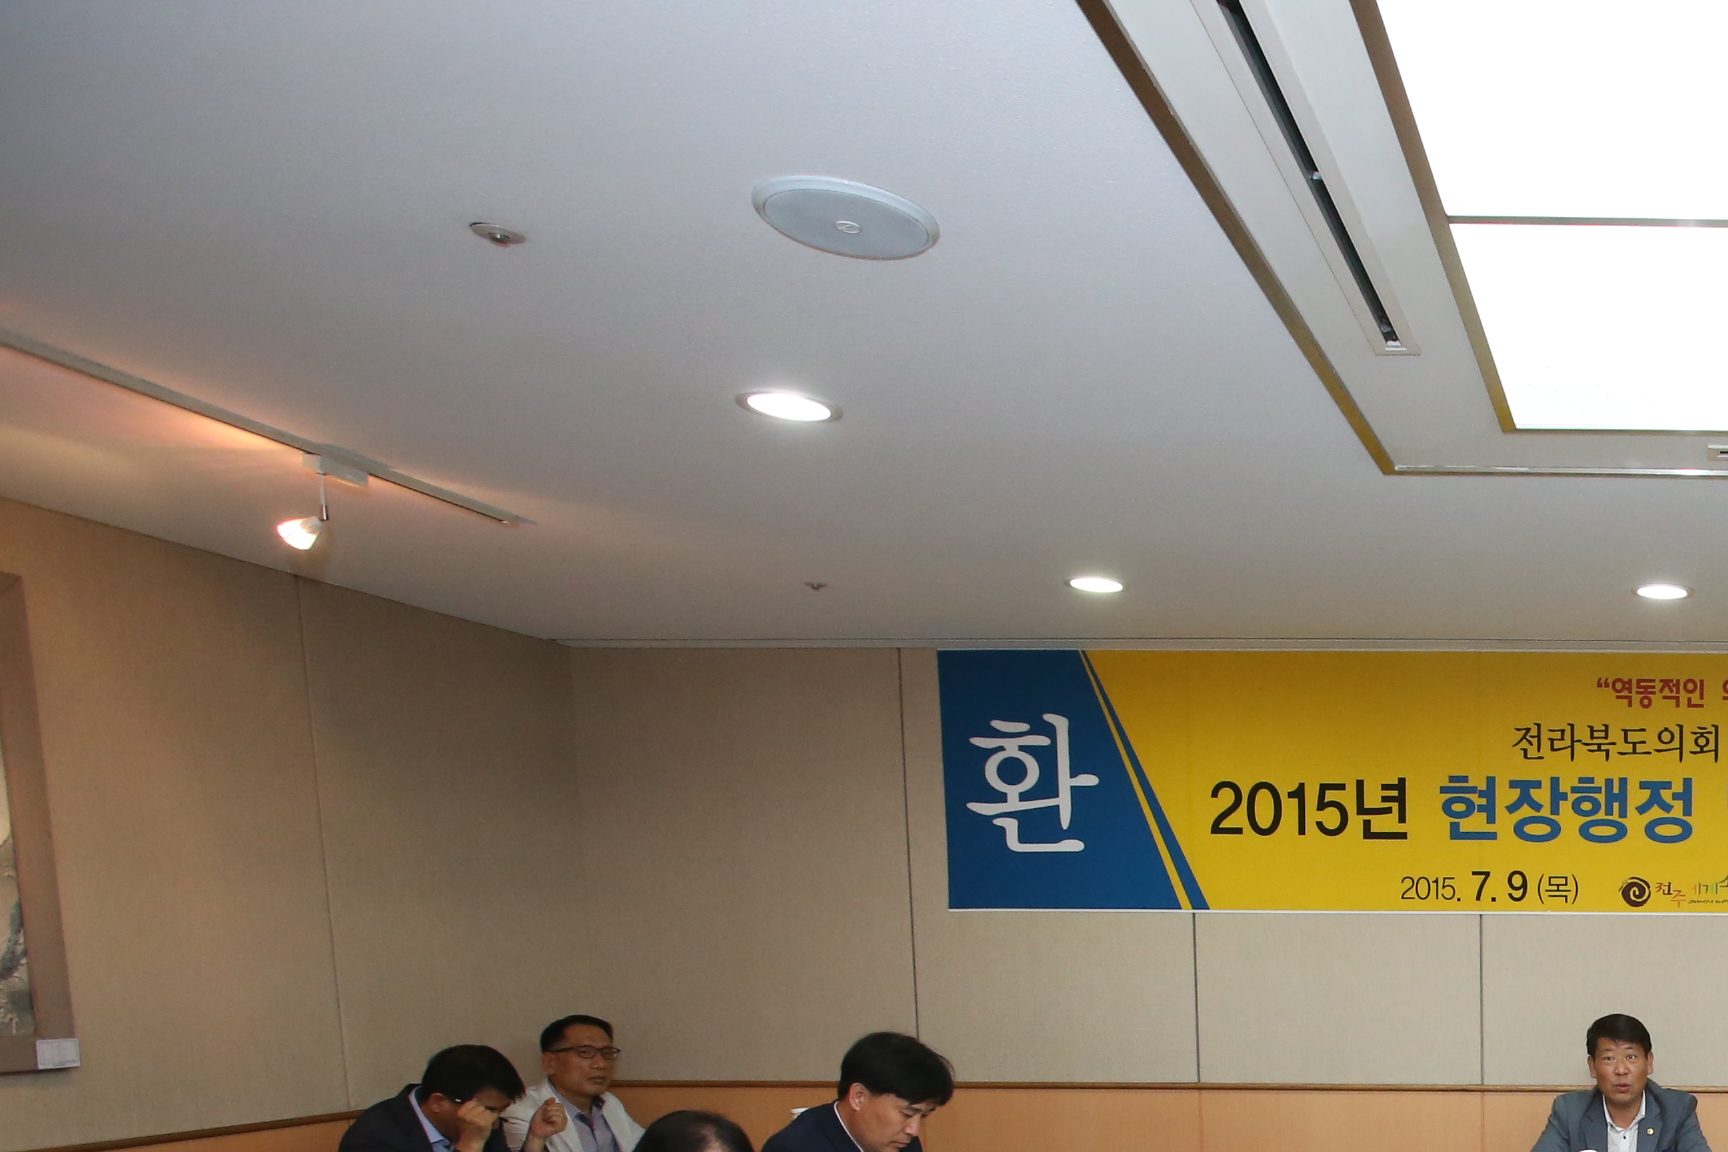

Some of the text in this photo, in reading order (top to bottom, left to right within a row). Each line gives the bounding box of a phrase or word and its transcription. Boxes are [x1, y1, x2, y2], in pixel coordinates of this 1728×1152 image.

[1512, 722, 1720, 763] 전라북도의회
[966, 713, 1100, 853] 환
[1210, 777, 1408, 840] 2015년
[1439, 775, 1693, 843] 현장행정
[1537, 873, 1579, 905] (목)
